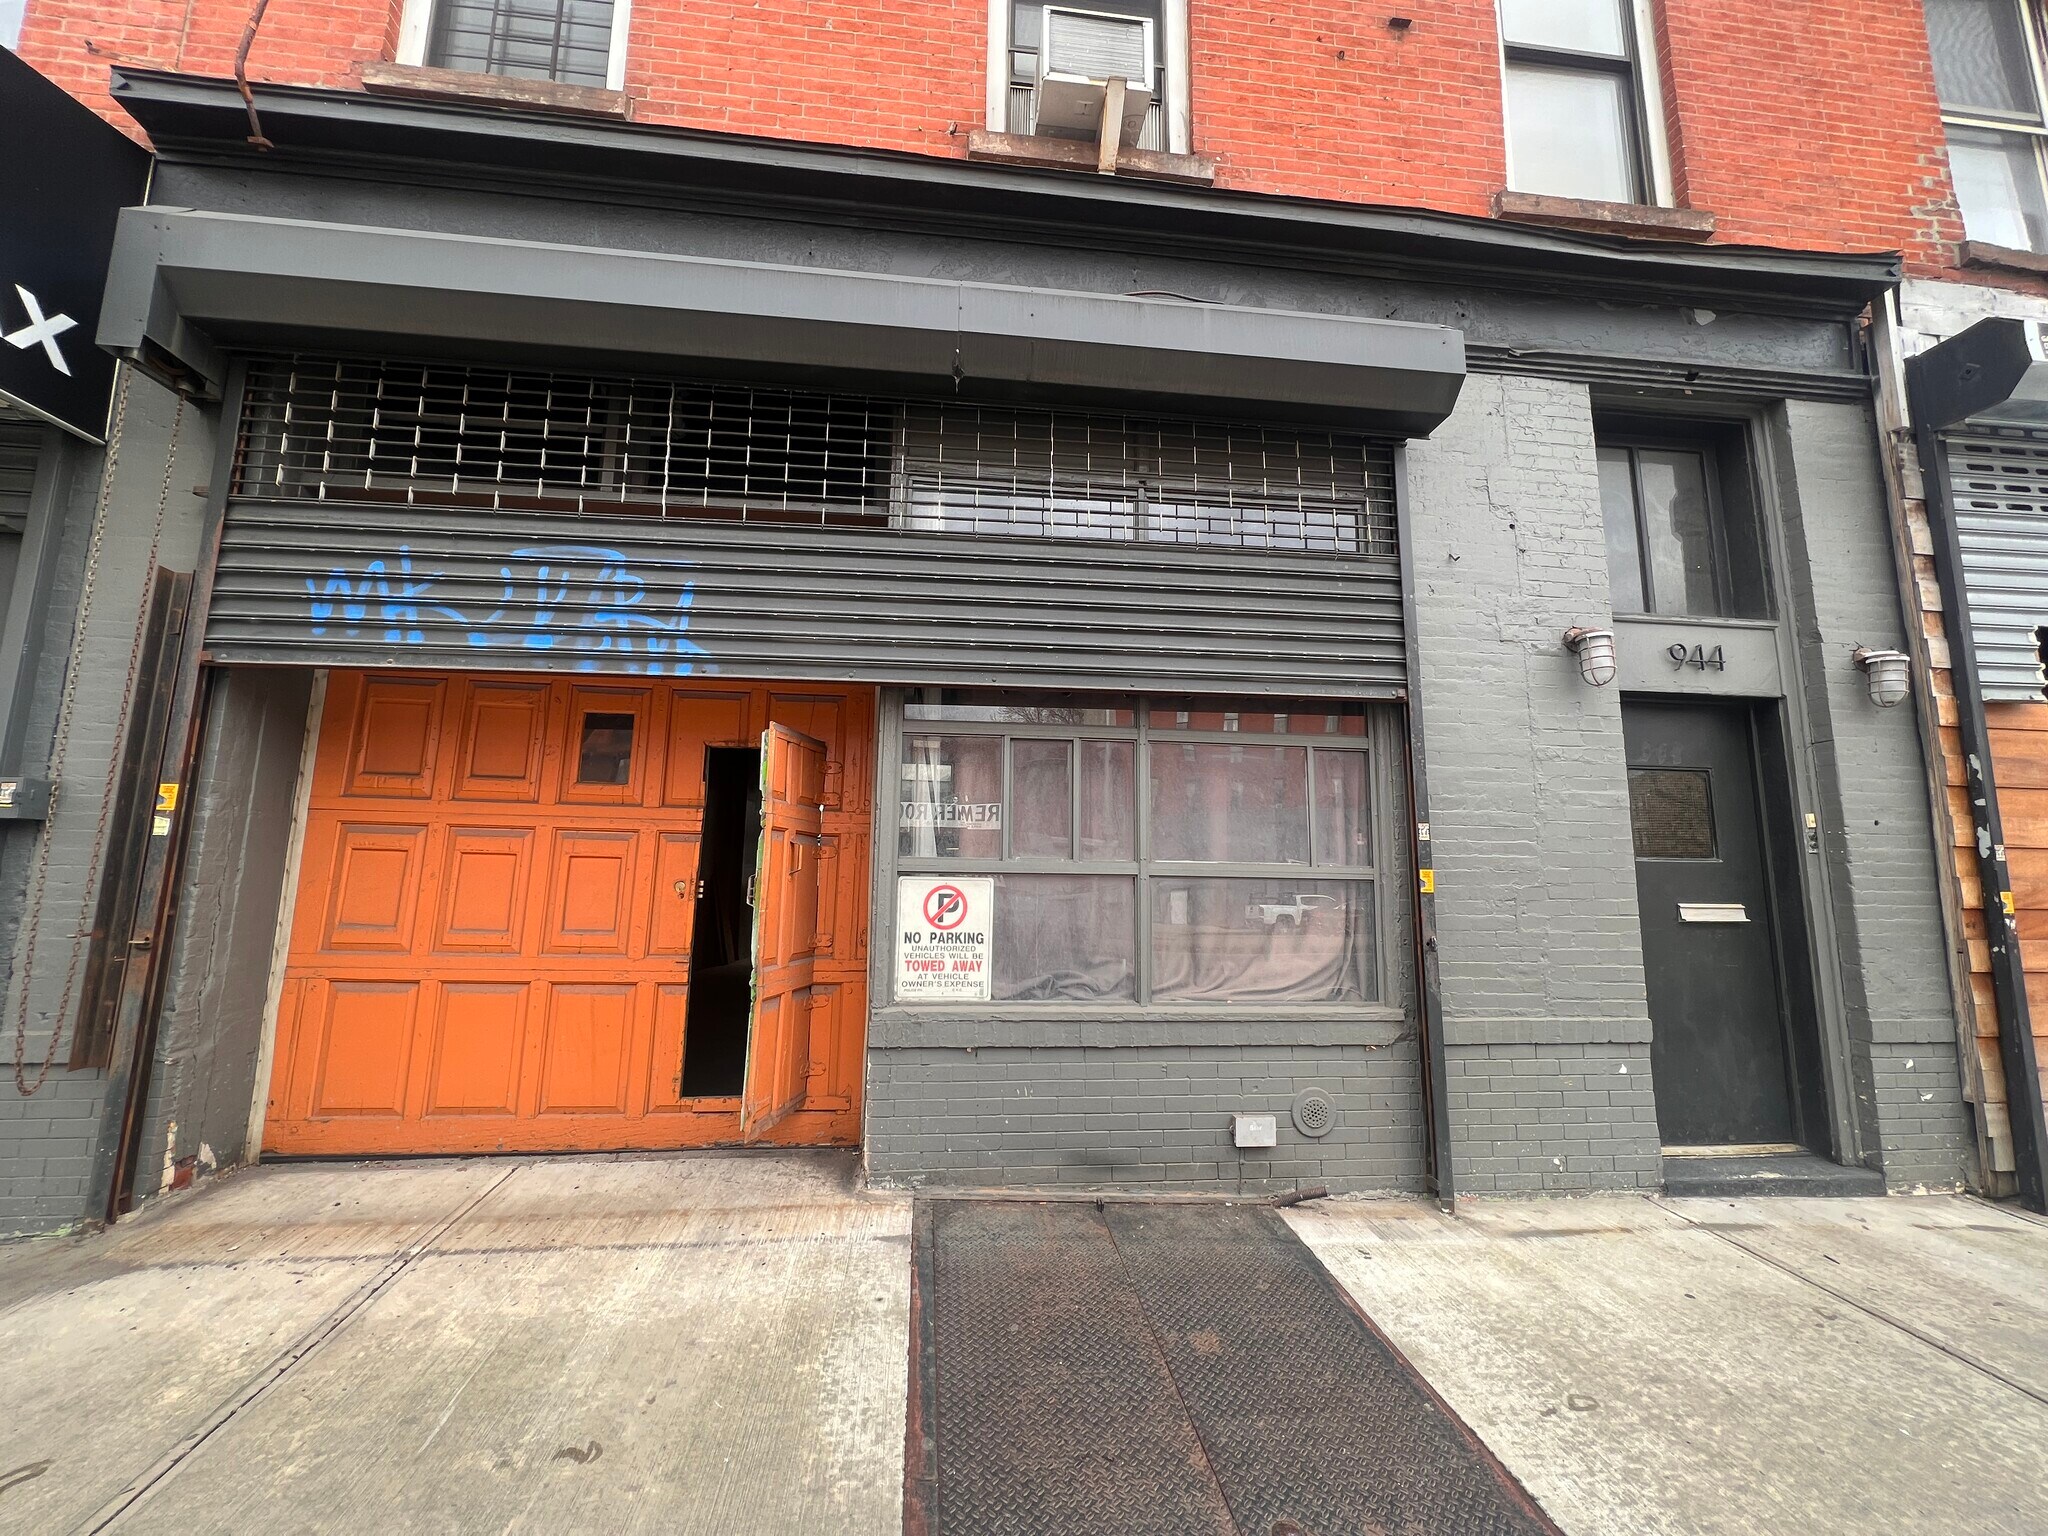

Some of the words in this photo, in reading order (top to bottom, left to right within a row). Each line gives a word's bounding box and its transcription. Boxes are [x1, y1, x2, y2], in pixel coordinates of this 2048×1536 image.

[1667, 643, 1726, 671] 944
[904, 932, 922, 944] NO
[930, 932, 985, 944] PARKING
[905, 960, 945, 972] TOWED
[952, 960, 982, 972] AWAY
